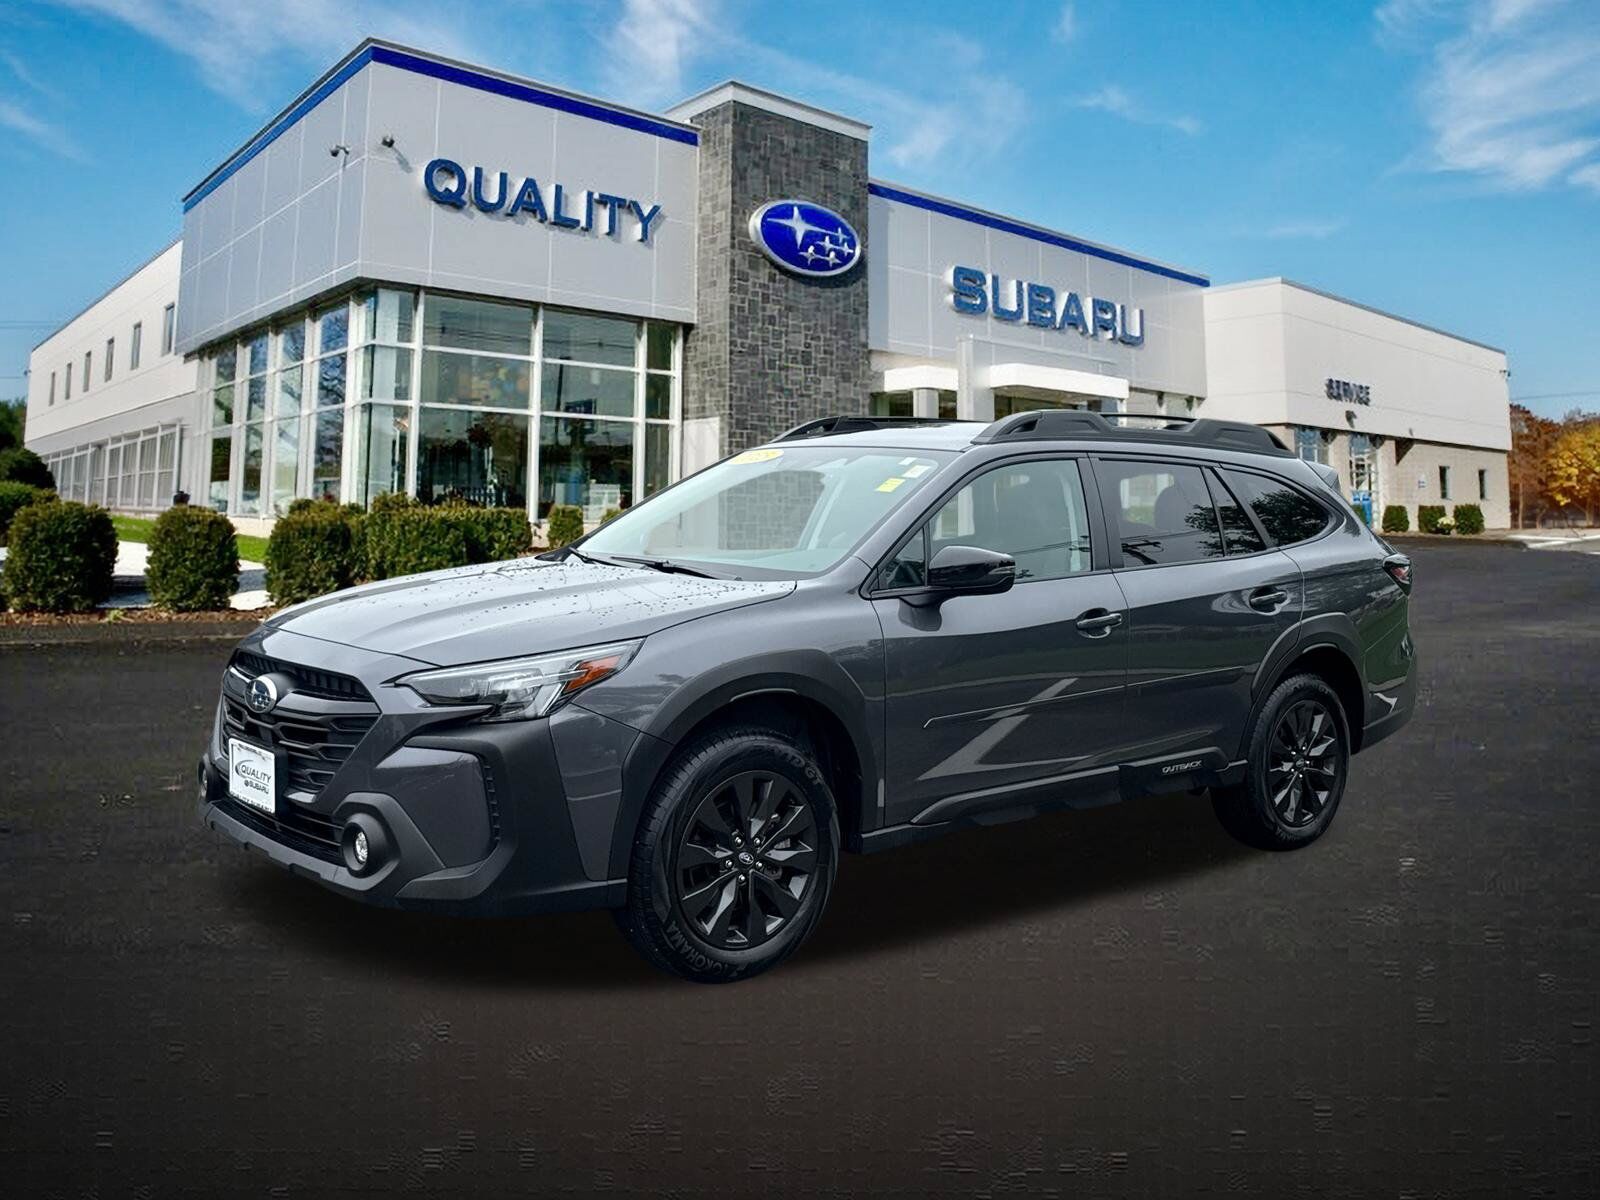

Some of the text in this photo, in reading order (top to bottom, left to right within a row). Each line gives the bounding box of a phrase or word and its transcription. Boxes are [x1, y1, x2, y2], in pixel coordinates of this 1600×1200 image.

[424, 158, 662, 243] QUALITY
[951, 265, 1145, 347] SUBARU
[1326, 378, 1370, 405] SERVICE
[241, 765, 271, 783] QUALITY
[1162, 760, 1202, 773] OUTBACK
[249, 781, 269, 794] SUBARU
